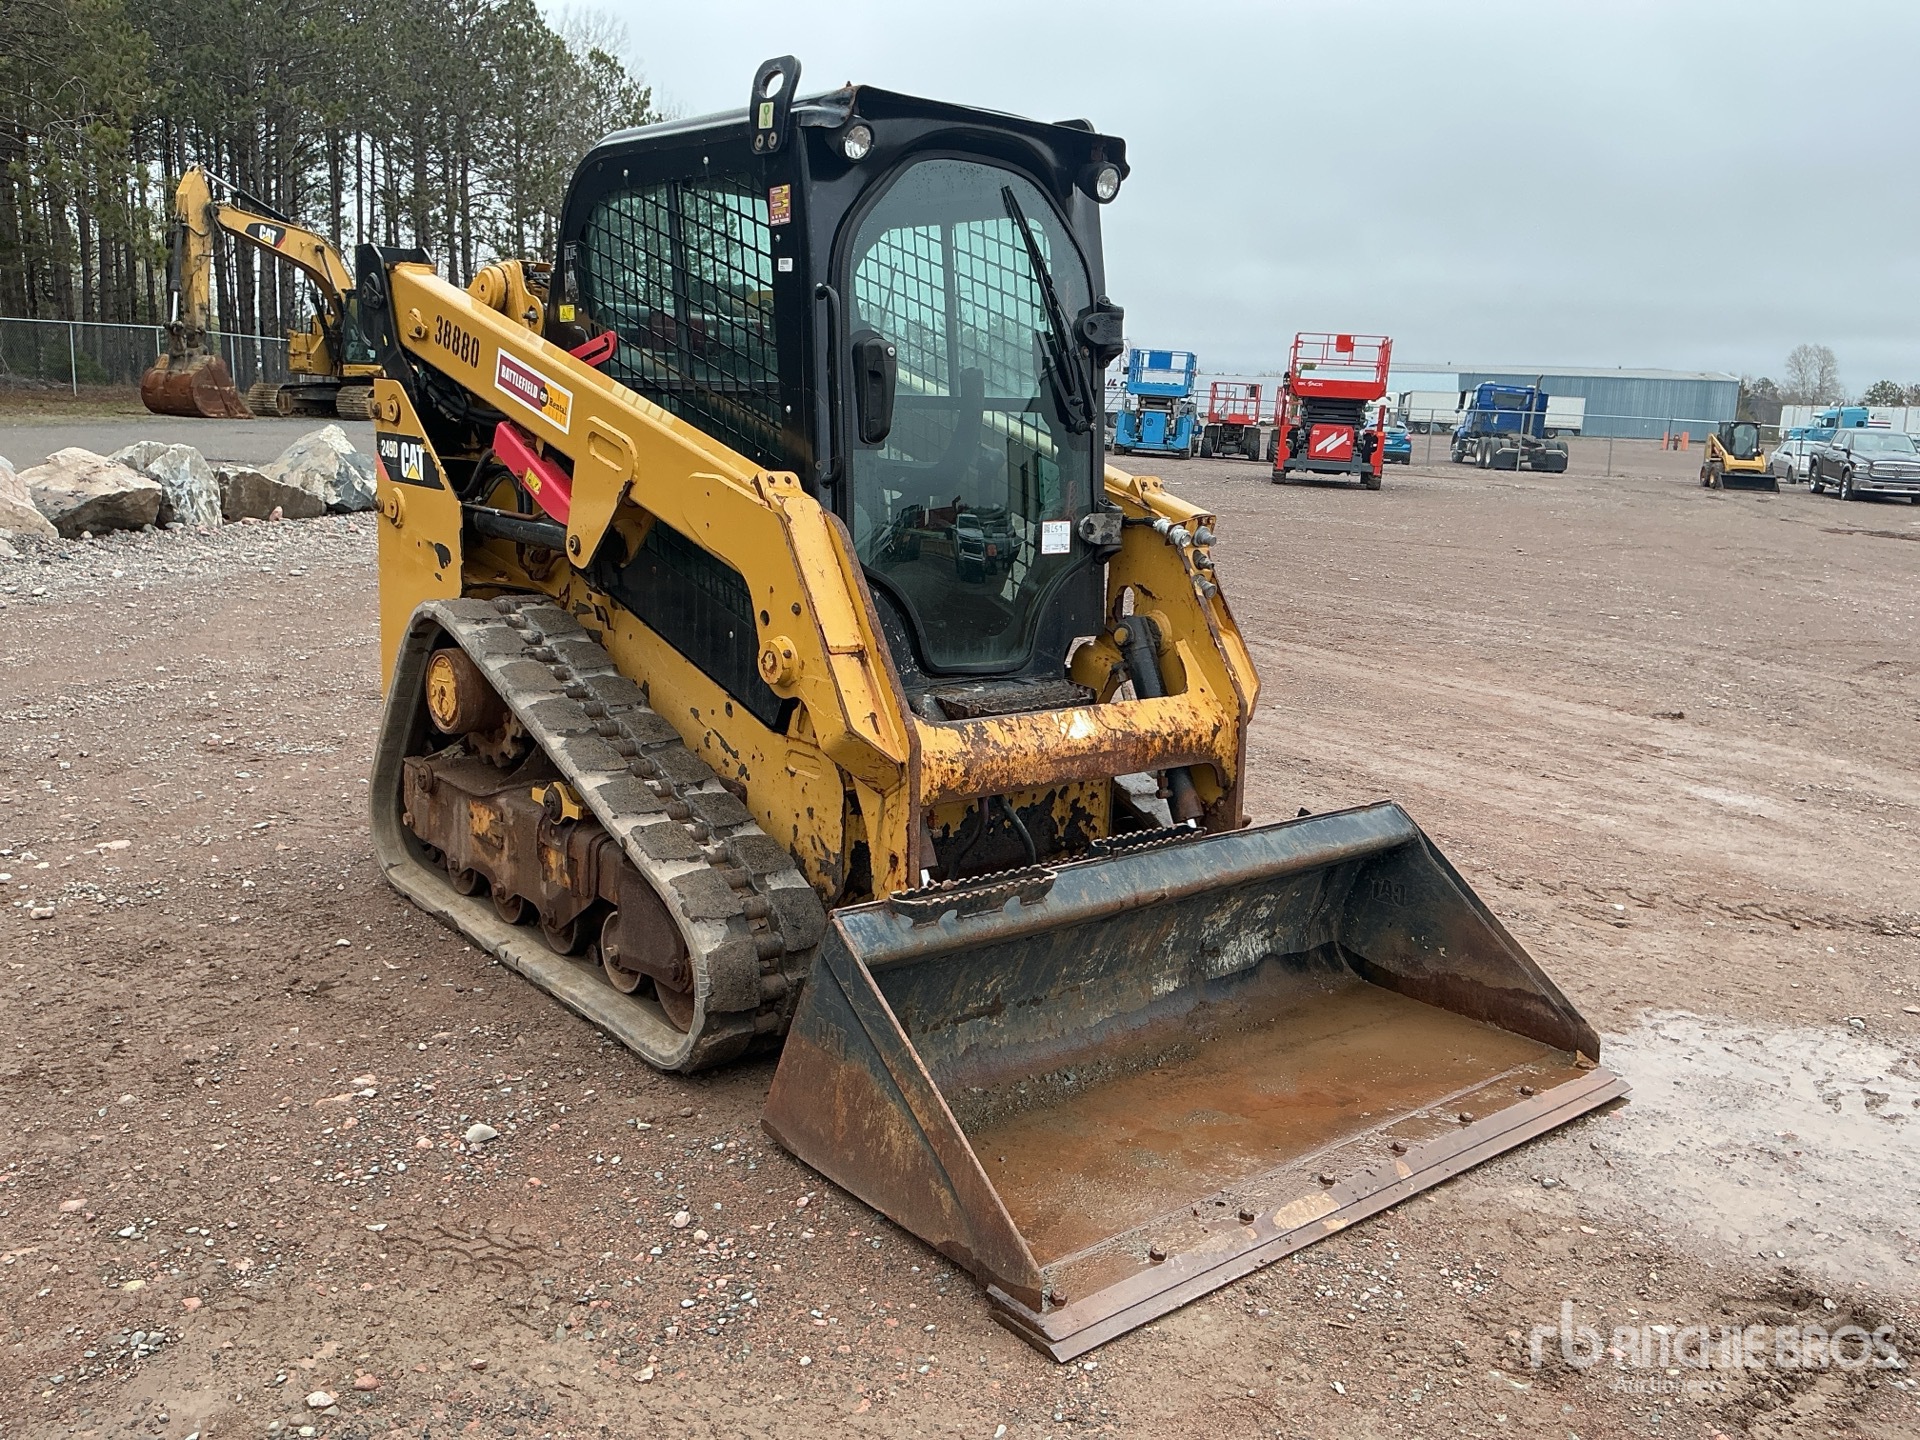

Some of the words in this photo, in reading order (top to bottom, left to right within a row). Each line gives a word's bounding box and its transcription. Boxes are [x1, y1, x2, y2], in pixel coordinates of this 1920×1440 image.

[259, 225, 277, 245] CAT
[434, 315, 480, 368] 38880
[501, 365, 538, 399] BATTLEFIELD
[549, 397, 567, 415] Rental
[401, 442, 425, 481] CAT
